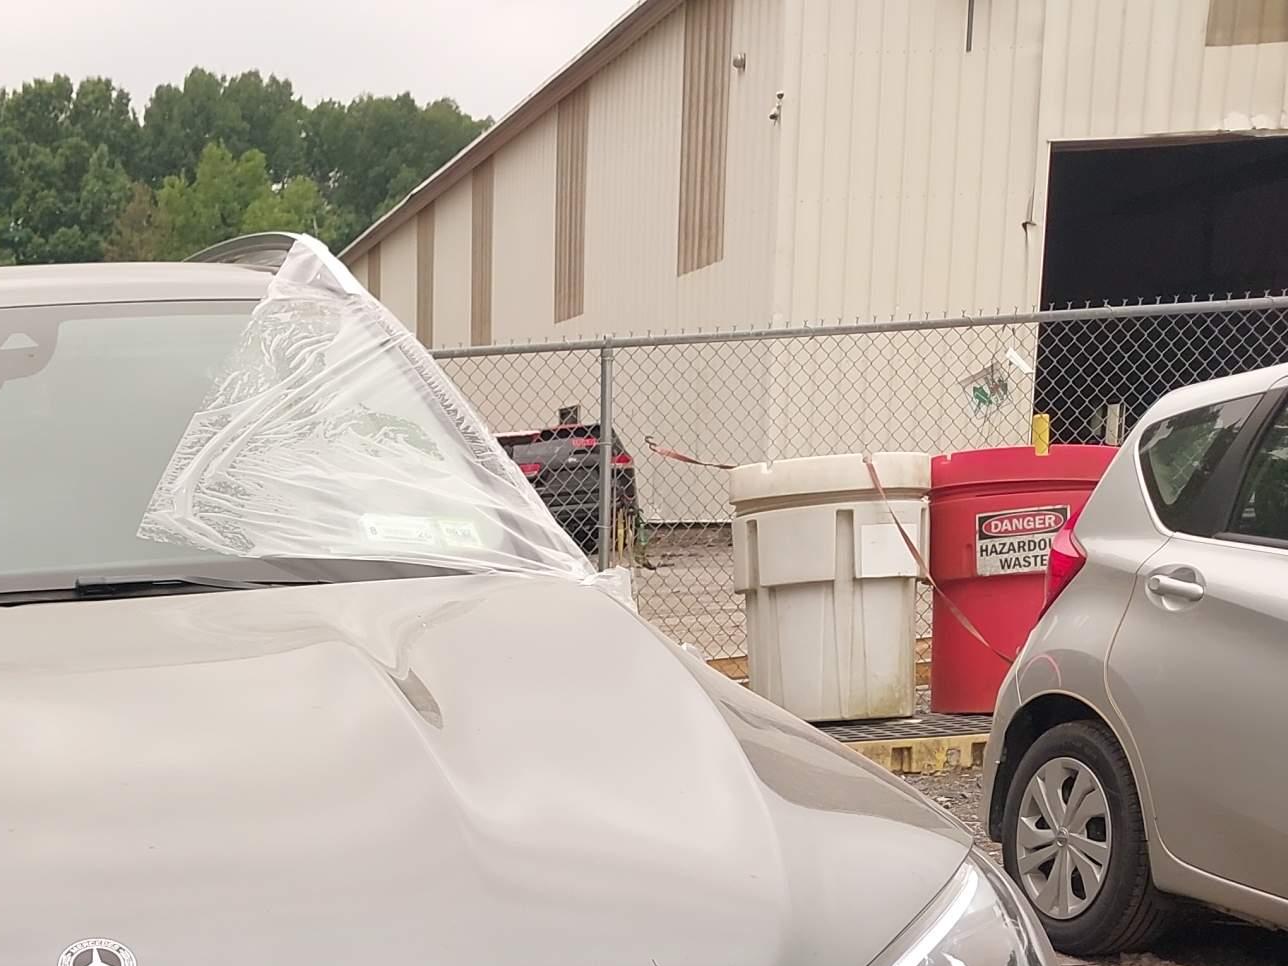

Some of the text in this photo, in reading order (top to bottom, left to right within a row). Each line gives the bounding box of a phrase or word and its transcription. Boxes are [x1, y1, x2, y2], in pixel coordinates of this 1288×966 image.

[990, 514, 1056, 533] DANGER
[979, 538, 1052, 557] HAZARDO
[999, 553, 1049, 570] WASTE
